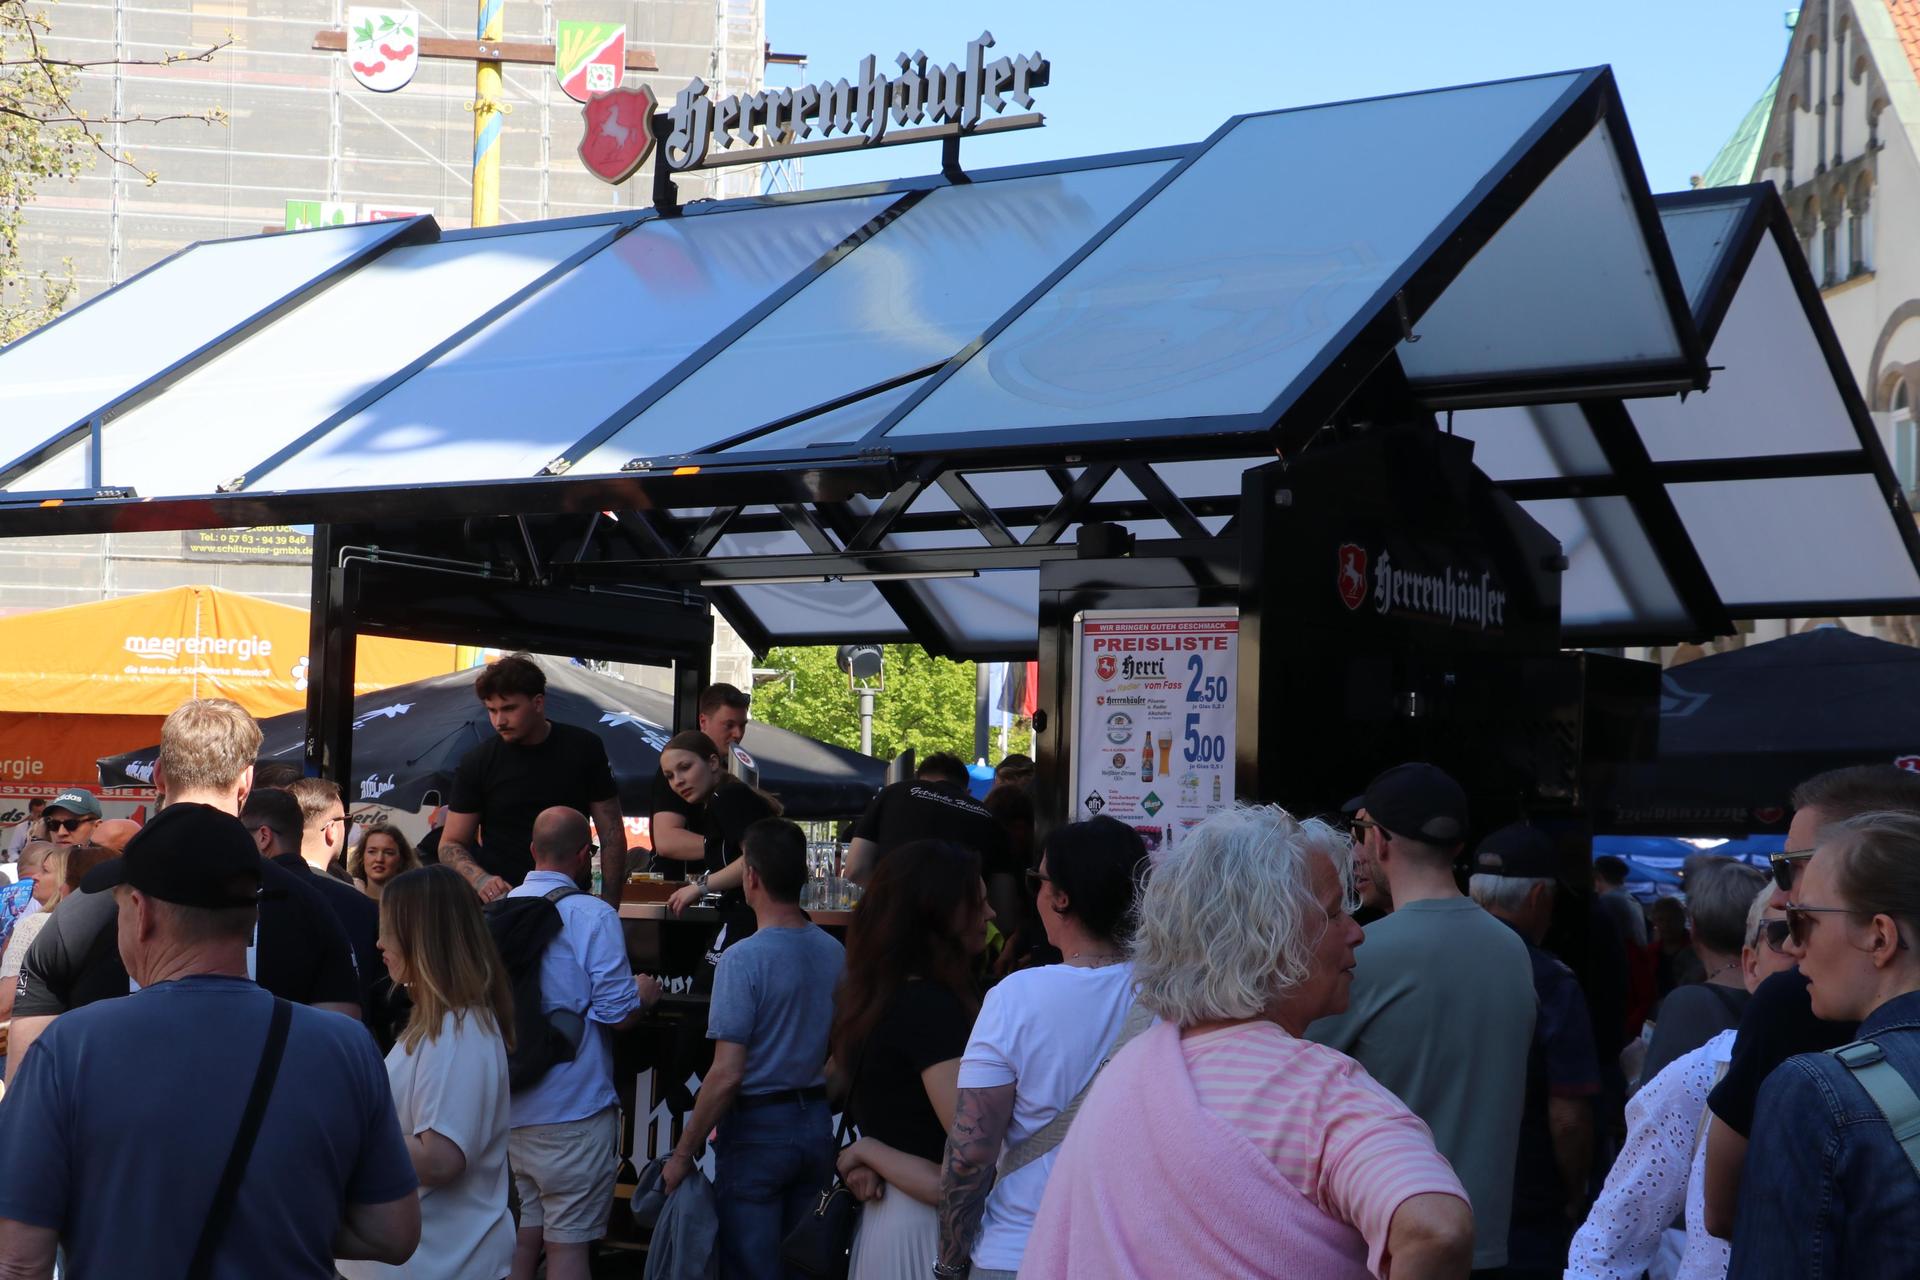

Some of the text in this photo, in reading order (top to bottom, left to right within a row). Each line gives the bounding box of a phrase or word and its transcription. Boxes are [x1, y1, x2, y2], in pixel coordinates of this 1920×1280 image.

[229, 535, 240, 544] 57
[241, 534, 254, 544] 63
[261, 536, 273, 545] 94
[1100, 622, 1227, 632] WIR BRINGEN GUTEN GESCHMACK
[126, 636, 273, 661] meerenergie
[1093, 636, 1228, 652] PREISLISTE
[1121, 654, 1165, 680] Herri
[1144, 682, 1162, 690] vom
[1162, 680, 1182, 690] Fass
[0, 757, 43, 780] rgie
[102, 788, 134, 796] SIE
[352, 810, 388, 824] erle
